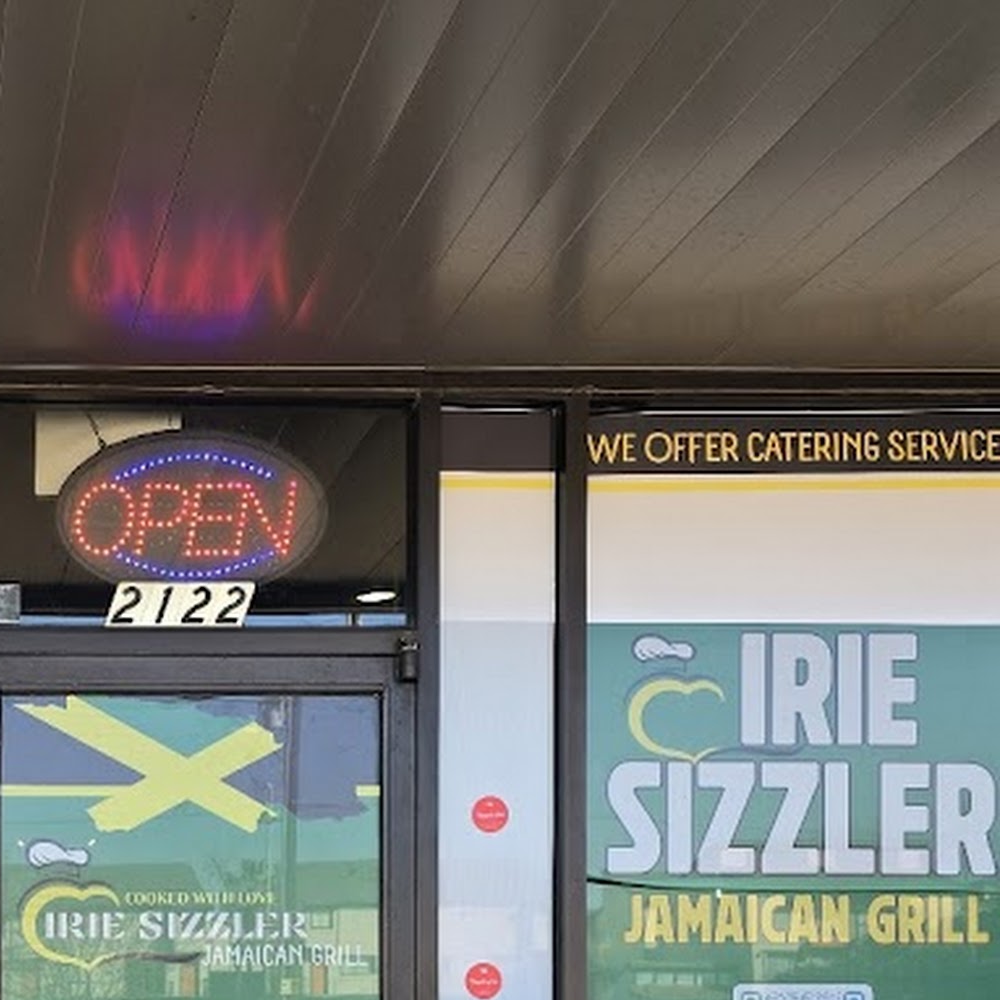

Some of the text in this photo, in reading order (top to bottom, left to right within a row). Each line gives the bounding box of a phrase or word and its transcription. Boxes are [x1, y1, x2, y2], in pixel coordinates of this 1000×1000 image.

[587, 433, 637, 464] WE
[644, 432, 740, 464] OFFER
[746, 430, 881, 463] CATERING
[69, 479, 299, 558] OPEN
[110, 584, 248, 625] 2122
[740, 632, 920, 746] IRIE
[605, 760, 998, 876] SIZZLER
[125, 890, 276, 906] COOKED WITH LOVE
[45, 911, 308, 940] IRIE SIZZLER
[624, 893, 991, 945] JAMAICAN GRILL
[201, 943, 370, 968] JAMAICAN GRILL
